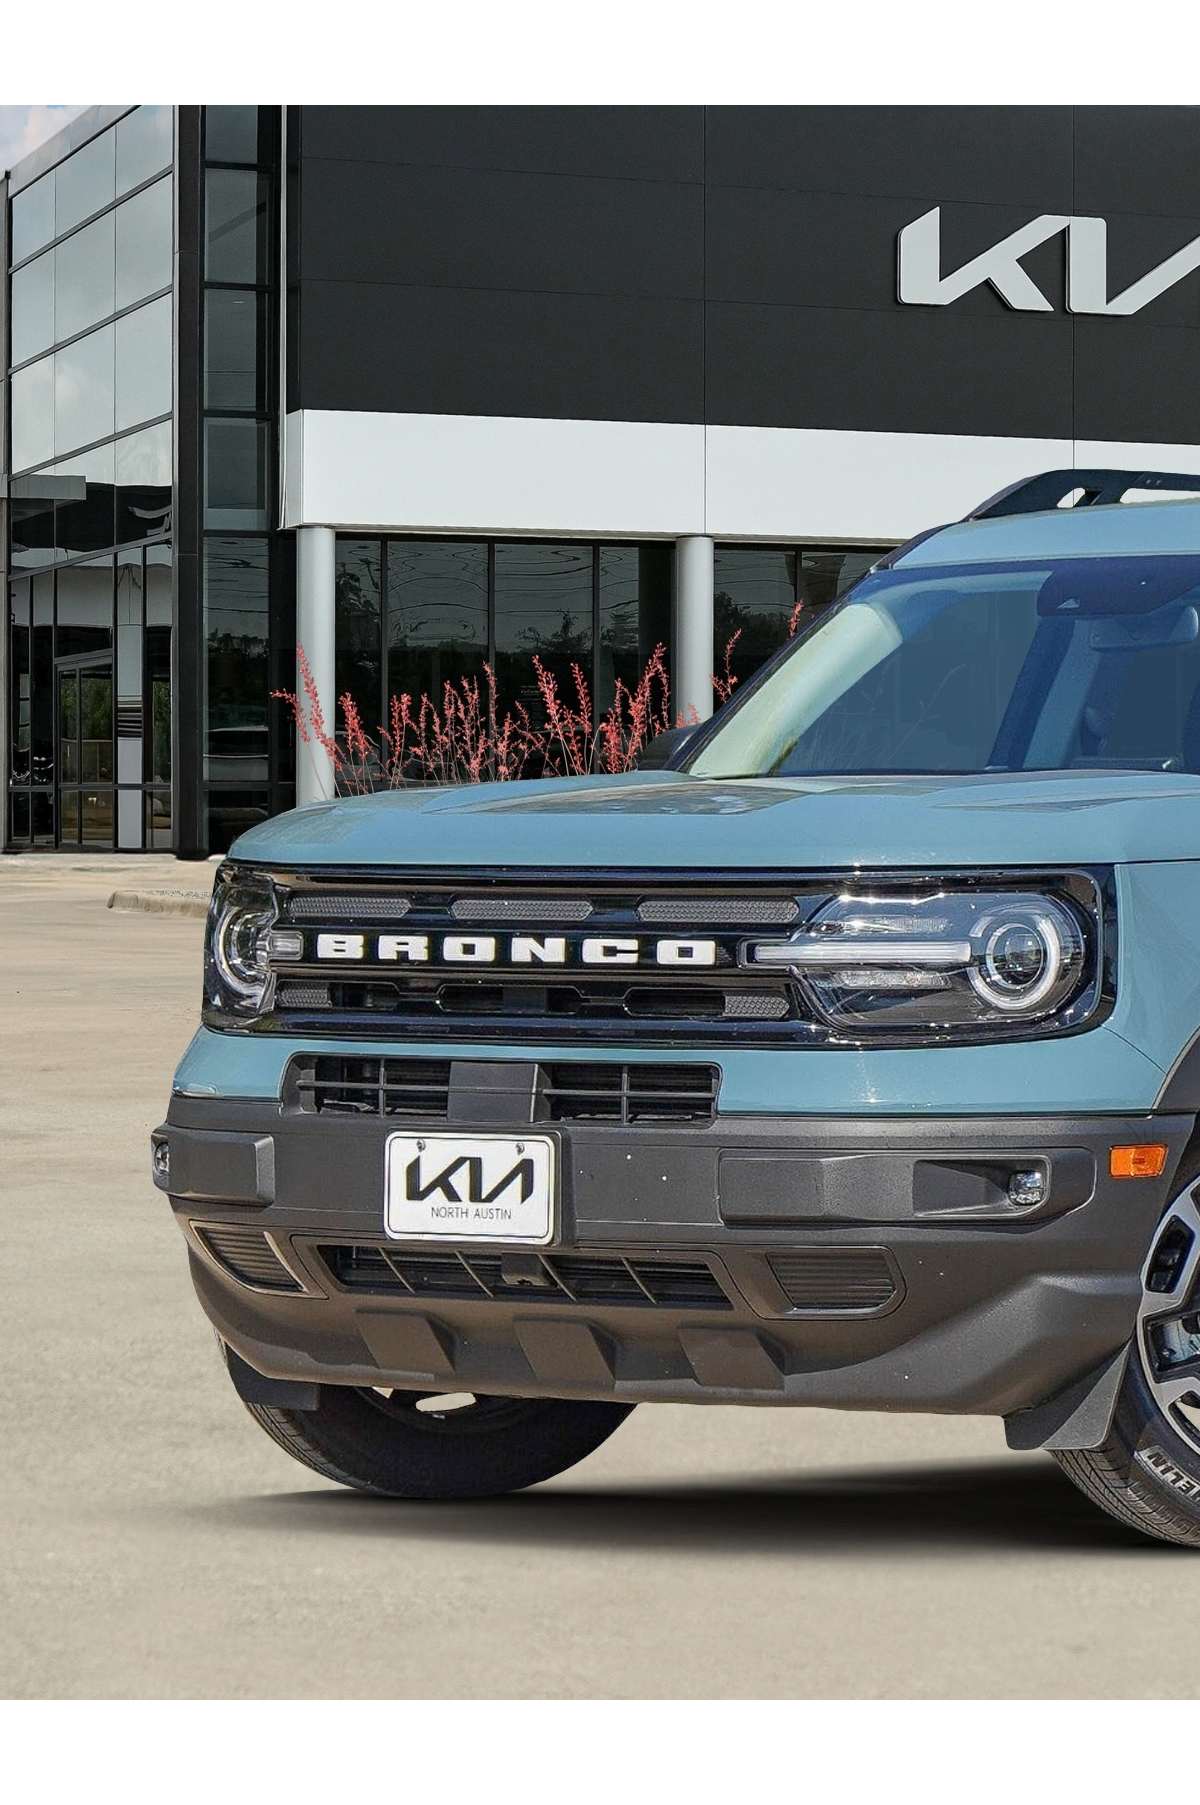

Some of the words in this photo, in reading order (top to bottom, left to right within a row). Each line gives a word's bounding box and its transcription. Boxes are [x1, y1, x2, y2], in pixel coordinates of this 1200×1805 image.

[317, 933, 716, 966] BRONCO
[405, 1154, 534, 1205] KIA
[431, 1207, 469, 1220] NORTH
[474, 1207, 512, 1220] AUSTIN
